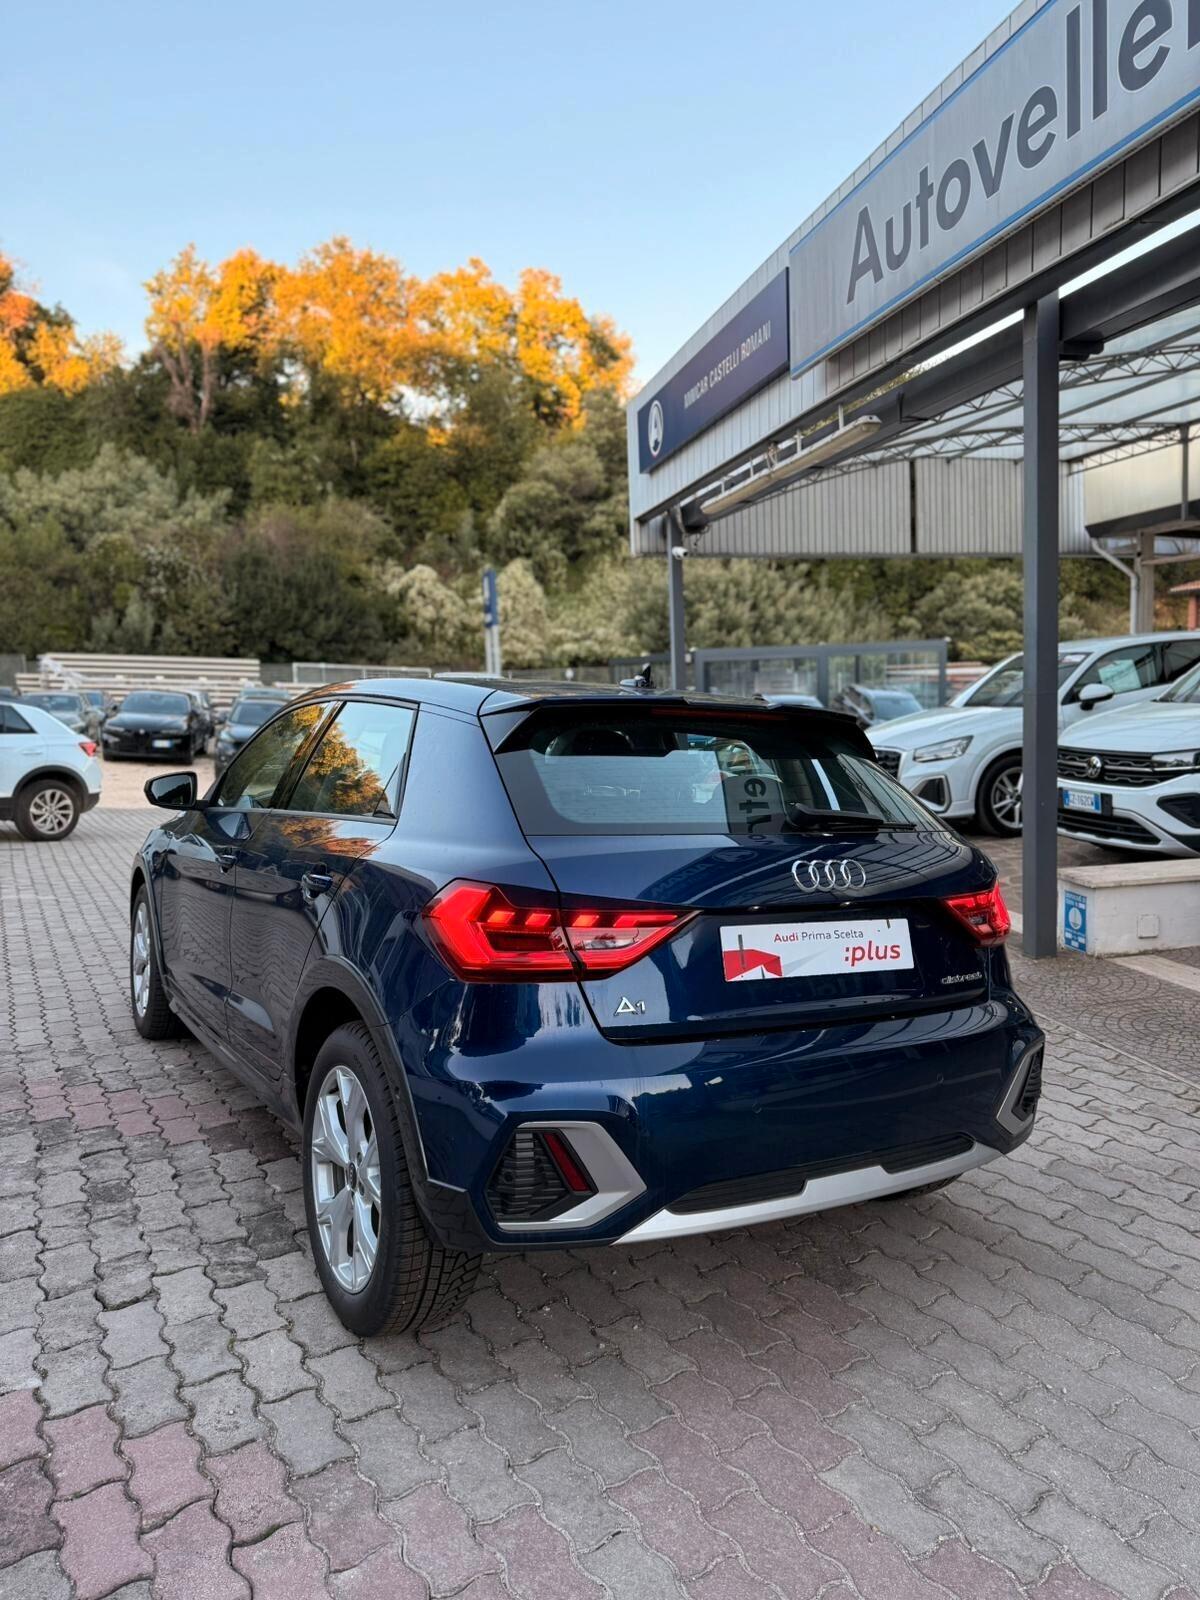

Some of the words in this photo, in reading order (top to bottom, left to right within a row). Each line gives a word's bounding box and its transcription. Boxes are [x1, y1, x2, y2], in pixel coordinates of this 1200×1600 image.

[847, 0, 1200, 305] Autovelle
[709, 348, 739, 388] CASTELLI
[741, 320, 771, 361] ROMANI
[773, 933, 799, 943] Audi
[802, 931, 832, 941] Prima
[834, 929, 864, 940] Scelta
[613, 996, 646, 1016] A1
